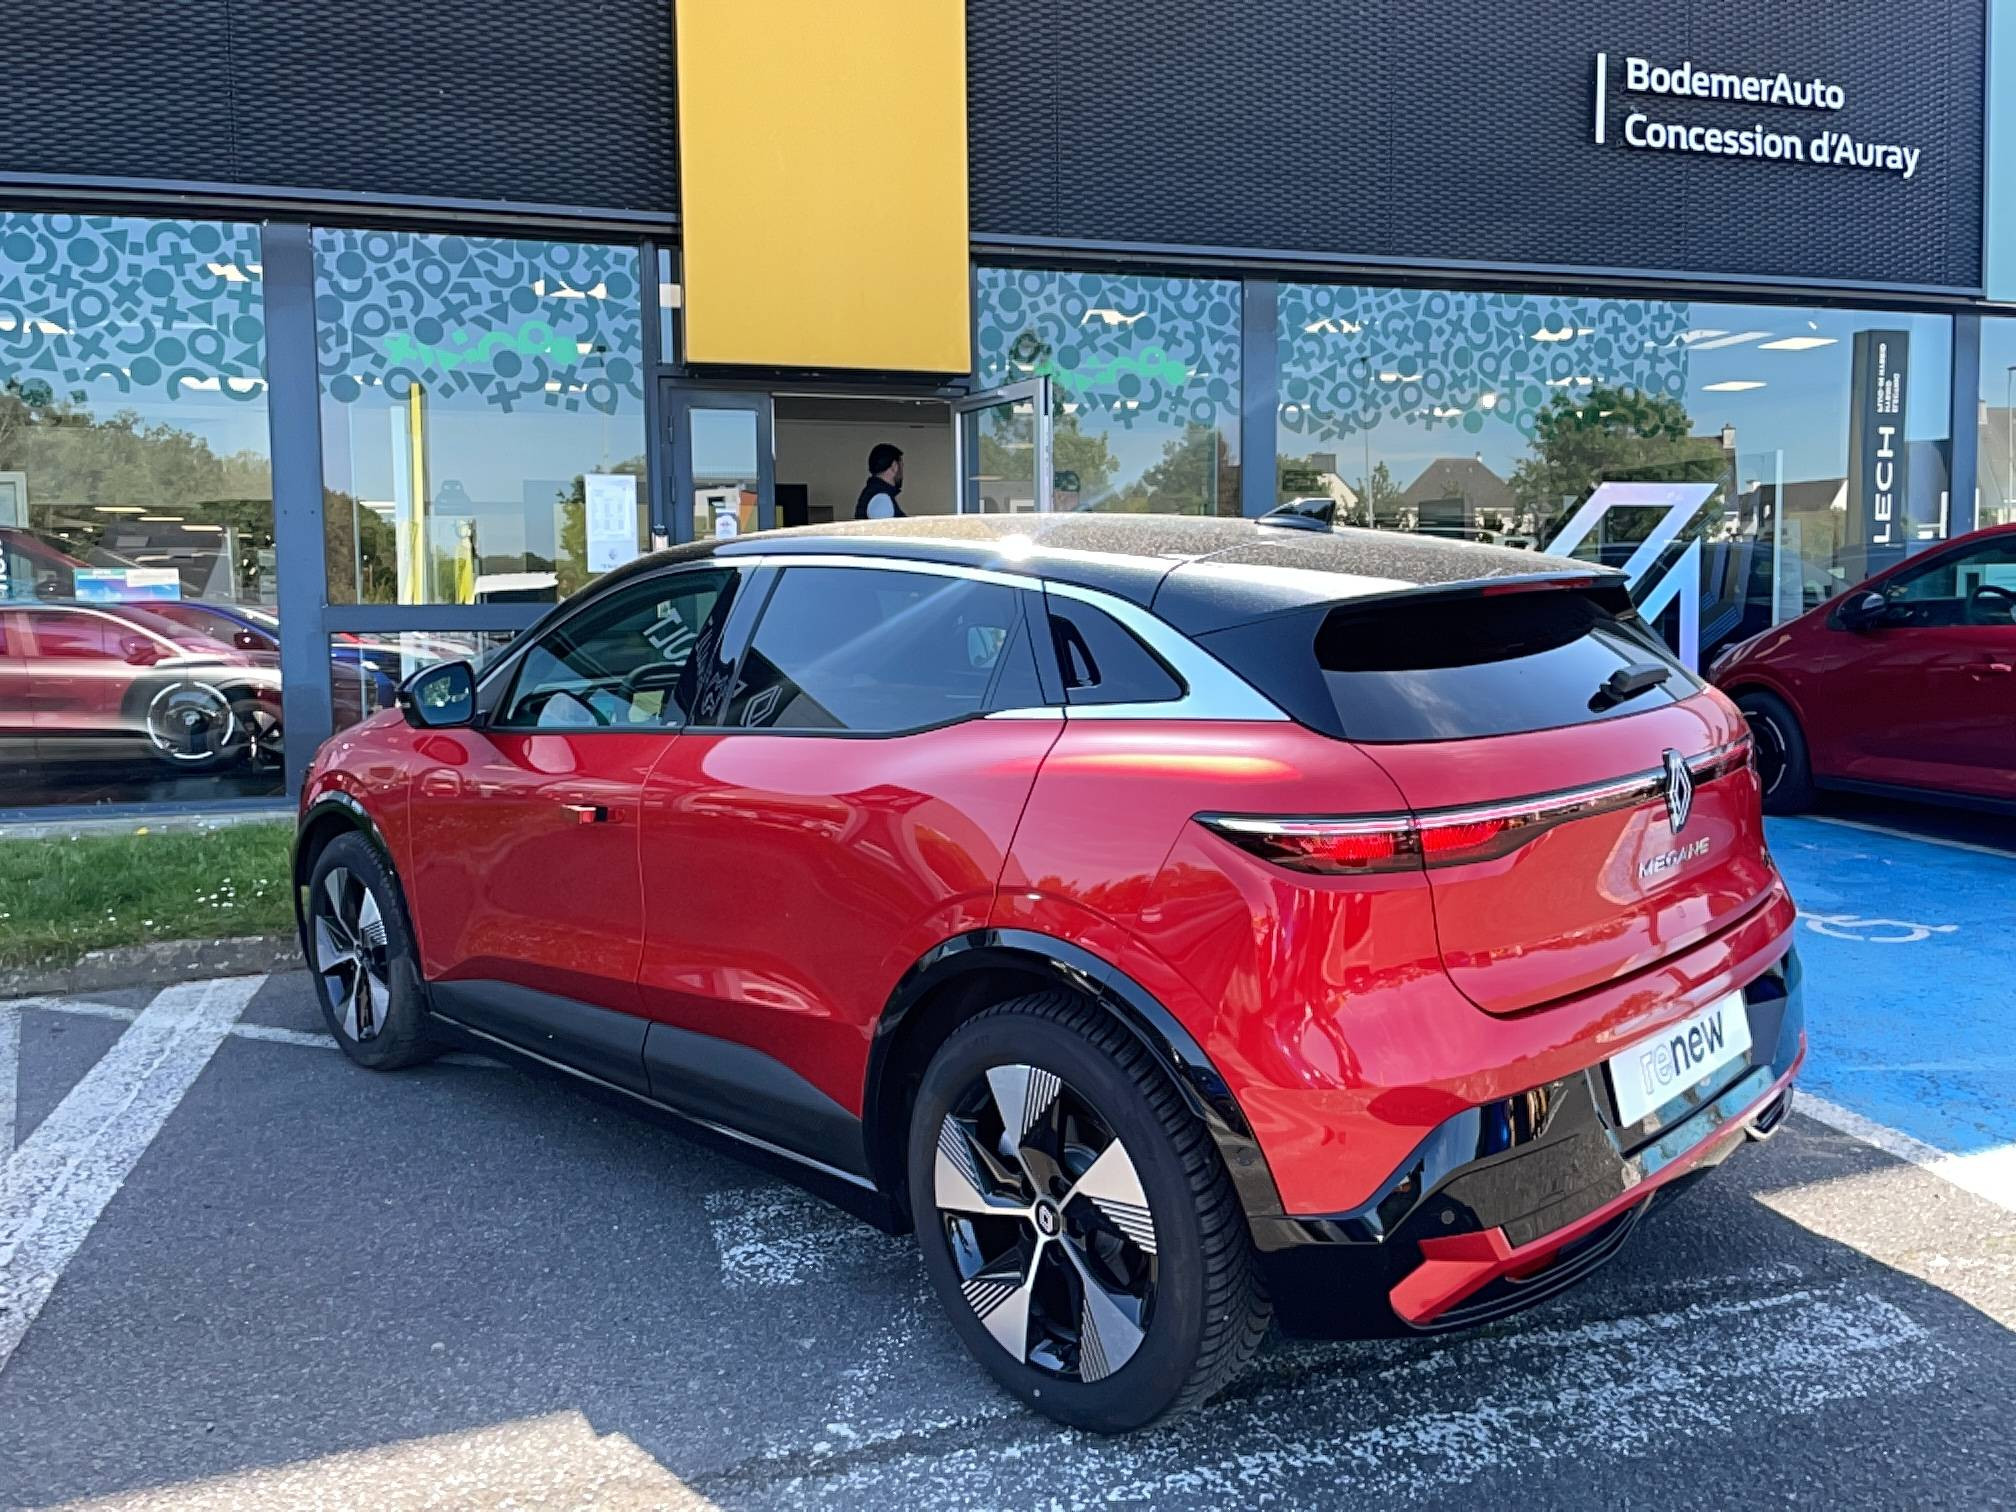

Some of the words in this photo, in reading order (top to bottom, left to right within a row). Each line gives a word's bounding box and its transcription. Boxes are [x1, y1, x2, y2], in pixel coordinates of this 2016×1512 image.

[1625, 57, 1845, 109] BodemerAuto
[1625, 113, 1803, 160] Concession
[1810, 131, 1920, 179] d'Auray
[1638, 836, 1710, 879] MEGANE
[1640, 1011, 1724, 1095] renew
